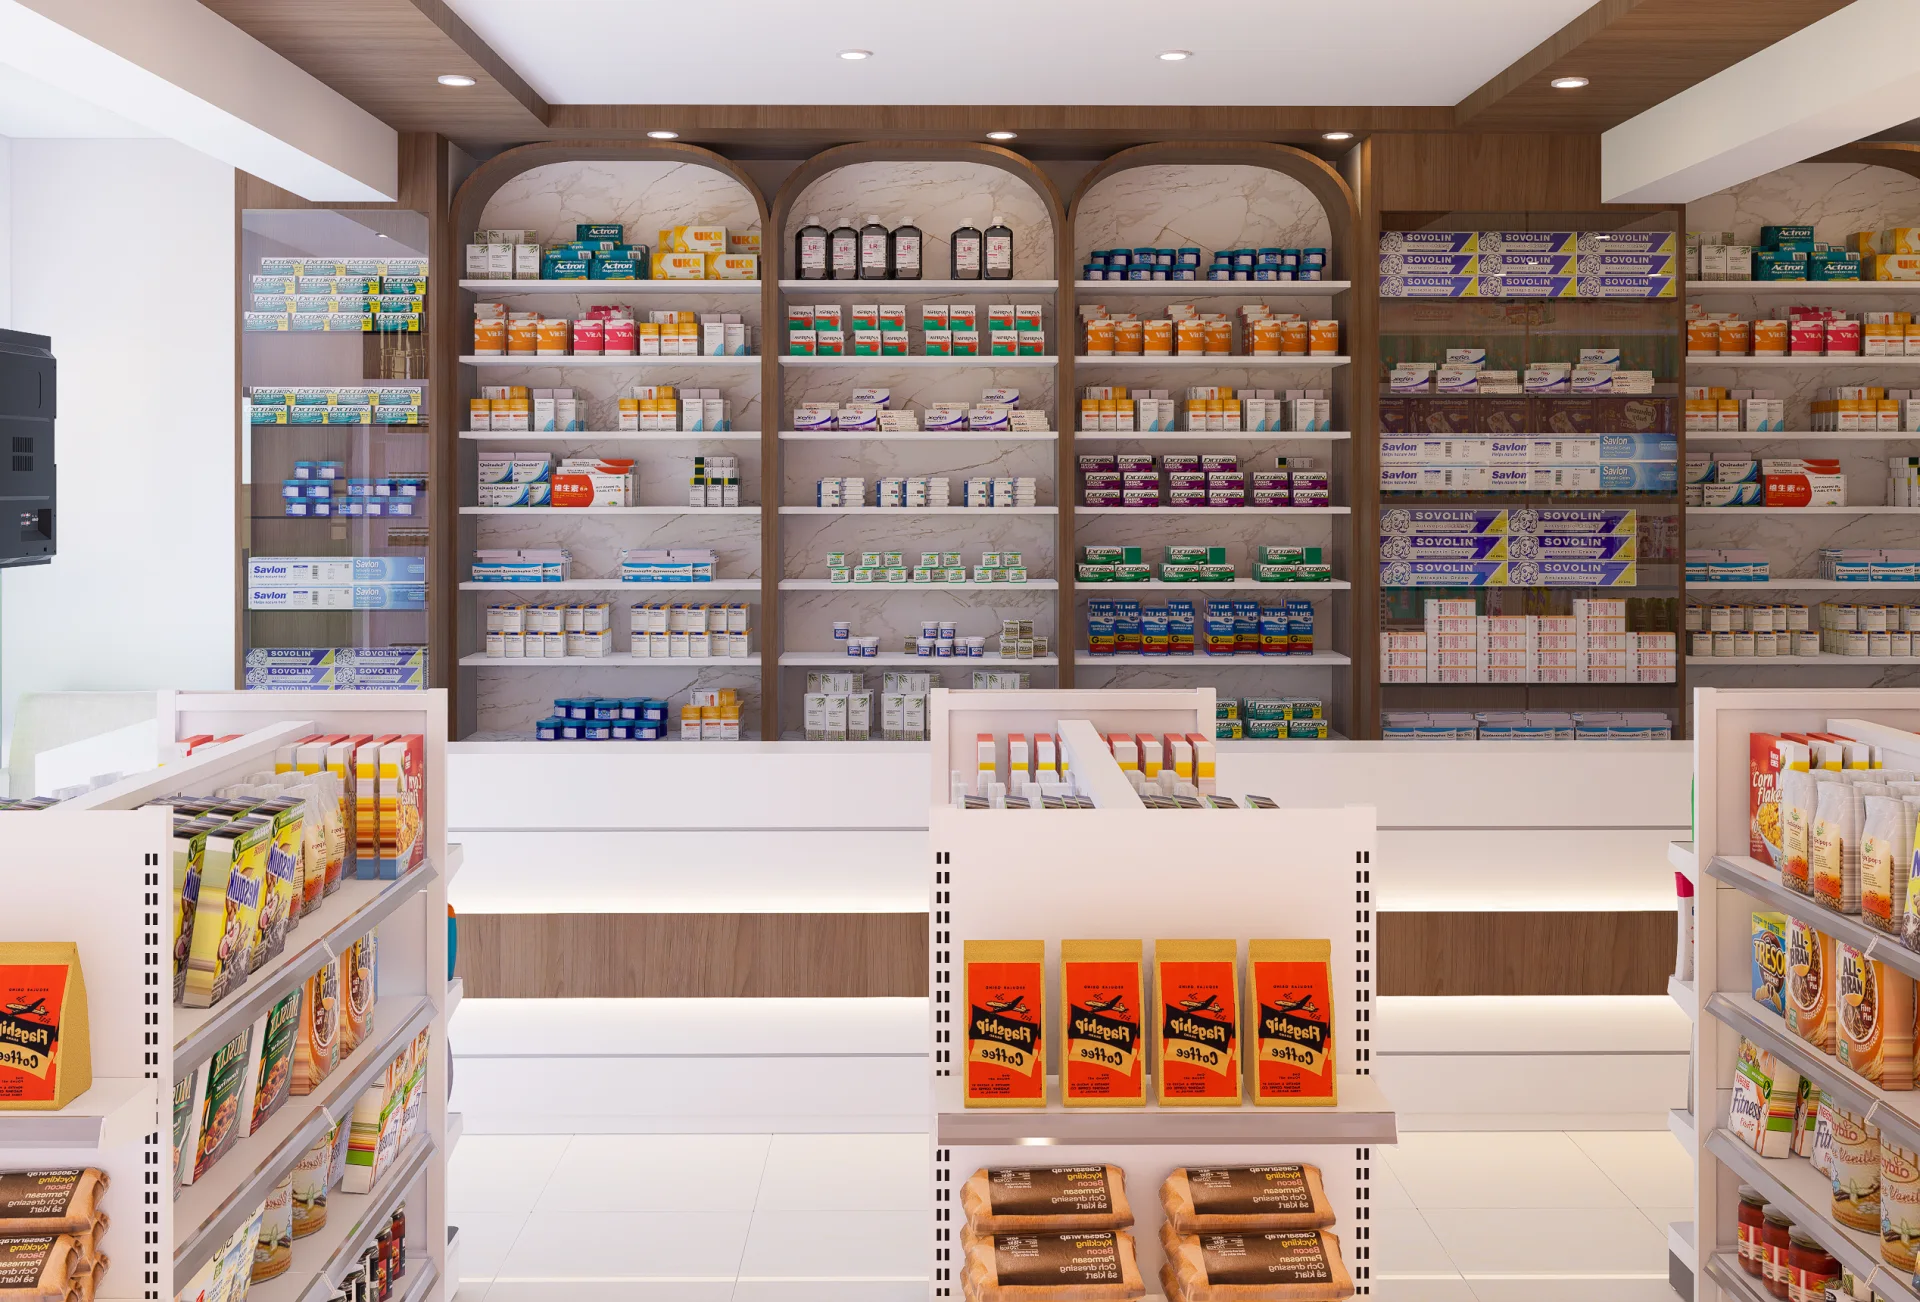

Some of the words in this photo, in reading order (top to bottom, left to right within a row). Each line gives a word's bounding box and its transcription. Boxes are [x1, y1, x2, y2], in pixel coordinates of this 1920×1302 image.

[588, 228, 618, 236] Actron
[1779, 229, 1811, 237] Actron
[1407, 256, 1451, 264] SOVOLIN
[1605, 256, 1649, 264] SOVOLIN
[1898, 260, 1920, 269] UK
[555, 262, 585, 270] Actron
[1602, 436, 1627, 445] Savlon
[1381, 443, 1417, 451] Savlon
[1491, 443, 1527, 451] Savlon
[1381, 471, 1417, 479] Savlon
[1602, 466, 1627, 476] Savlon
[1544, 512, 1601, 521] SOVOLIN
[1416, 537, 1473, 546] SOVOLIN
[1544, 537, 1601, 546] SOVOLIN
[356, 560, 379, 568] Savlon
[1416, 564, 1473, 572] SOVOLIN
[1544, 564, 1601, 572] SOVOLIN
[1753, 771, 1773, 789] Corn
[1757, 787, 1782, 805] flake
[1790, 948, 1809, 966] BRAN
[1841, 976, 1862, 996] BRAN
[1863, 1011, 1872, 1021] Plus
[1731, 1087, 1762, 1121] Fitness
[1832, 1121, 1858, 1146] ybio
